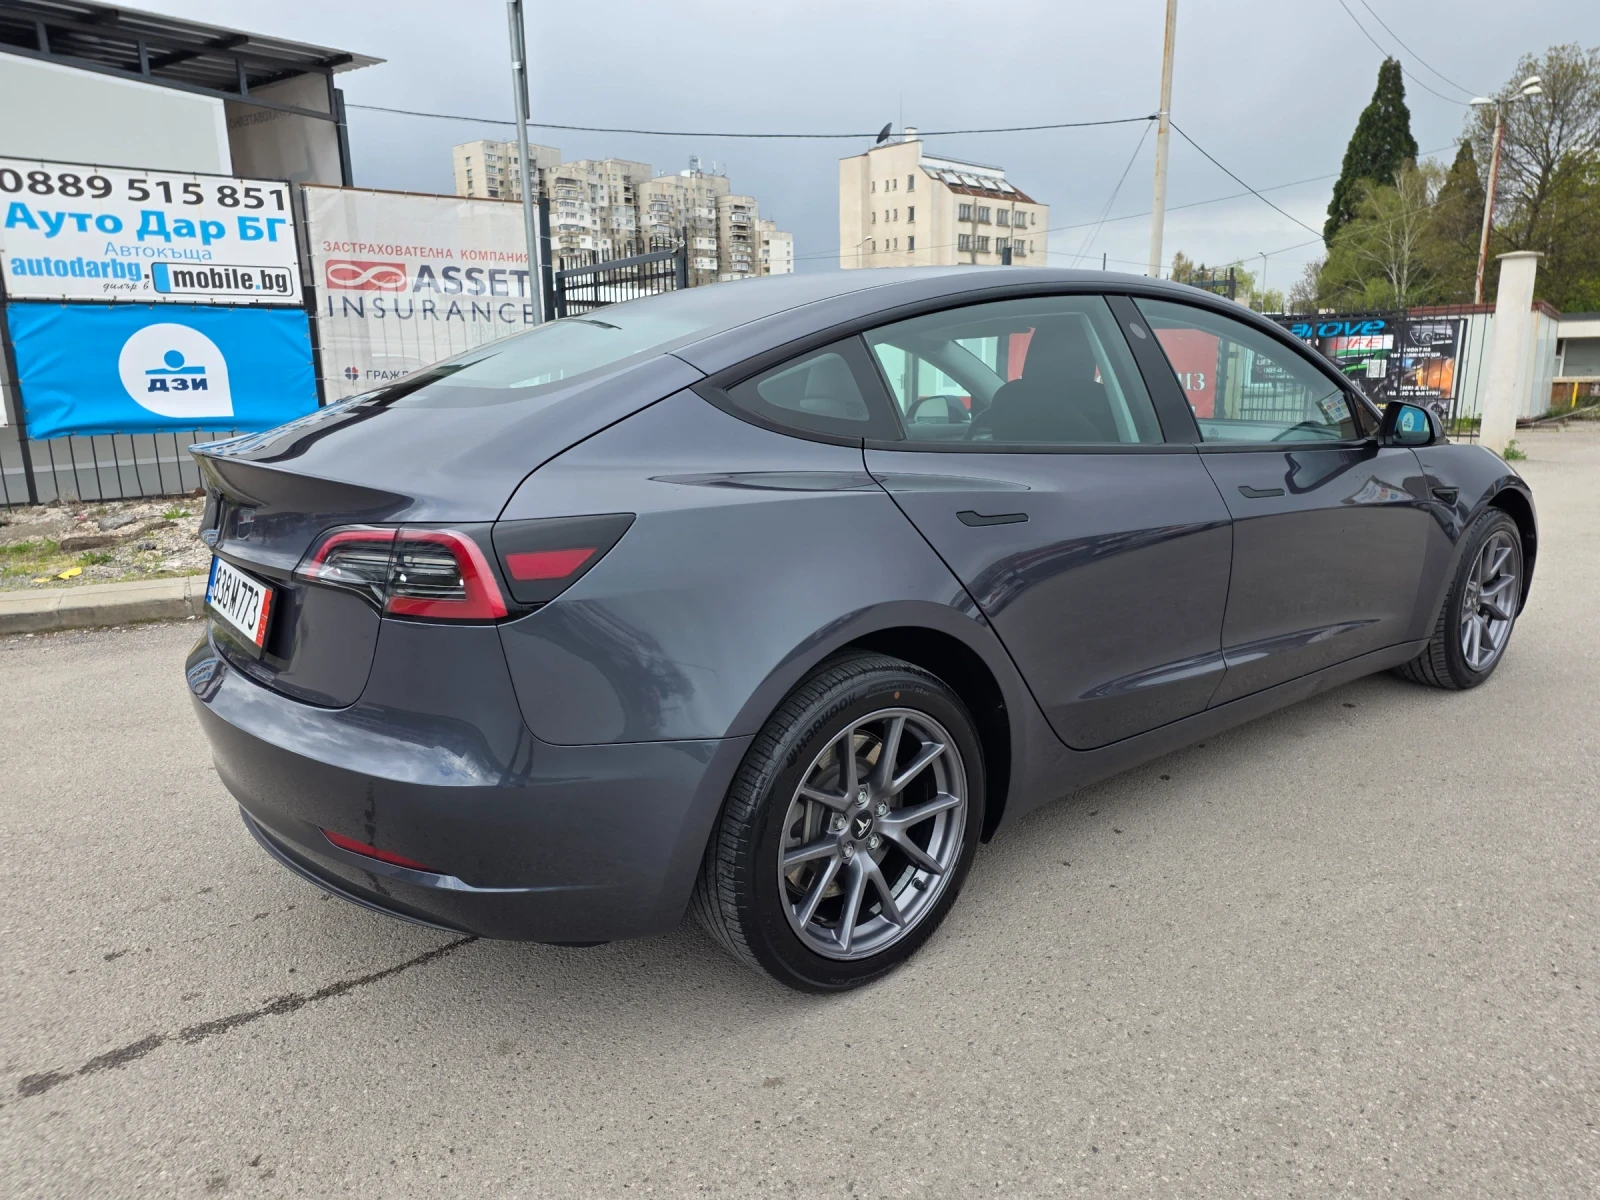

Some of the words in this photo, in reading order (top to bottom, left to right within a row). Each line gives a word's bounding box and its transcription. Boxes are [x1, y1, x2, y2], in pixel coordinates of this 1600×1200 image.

[0, 168, 113, 199] 0889
[127, 178, 204, 206] 515
[217, 185, 285, 212] 851
[5, 202, 123, 239] Ауто
[136, 210, 226, 246] Дар
[237, 216, 287, 242] БГ
[104, 242, 213, 262] Автокъща
[323, 241, 454, 260] ЗАСТРАХОВАТЕЛНА
[461, 250, 530, 263] КОМПАНИЯ
[173, 268, 288, 293] mobile.bg
[413, 265, 530, 297] ASSET
[327, 295, 534, 324] INSURANCE
[147, 377, 208, 392] ДЗИ
